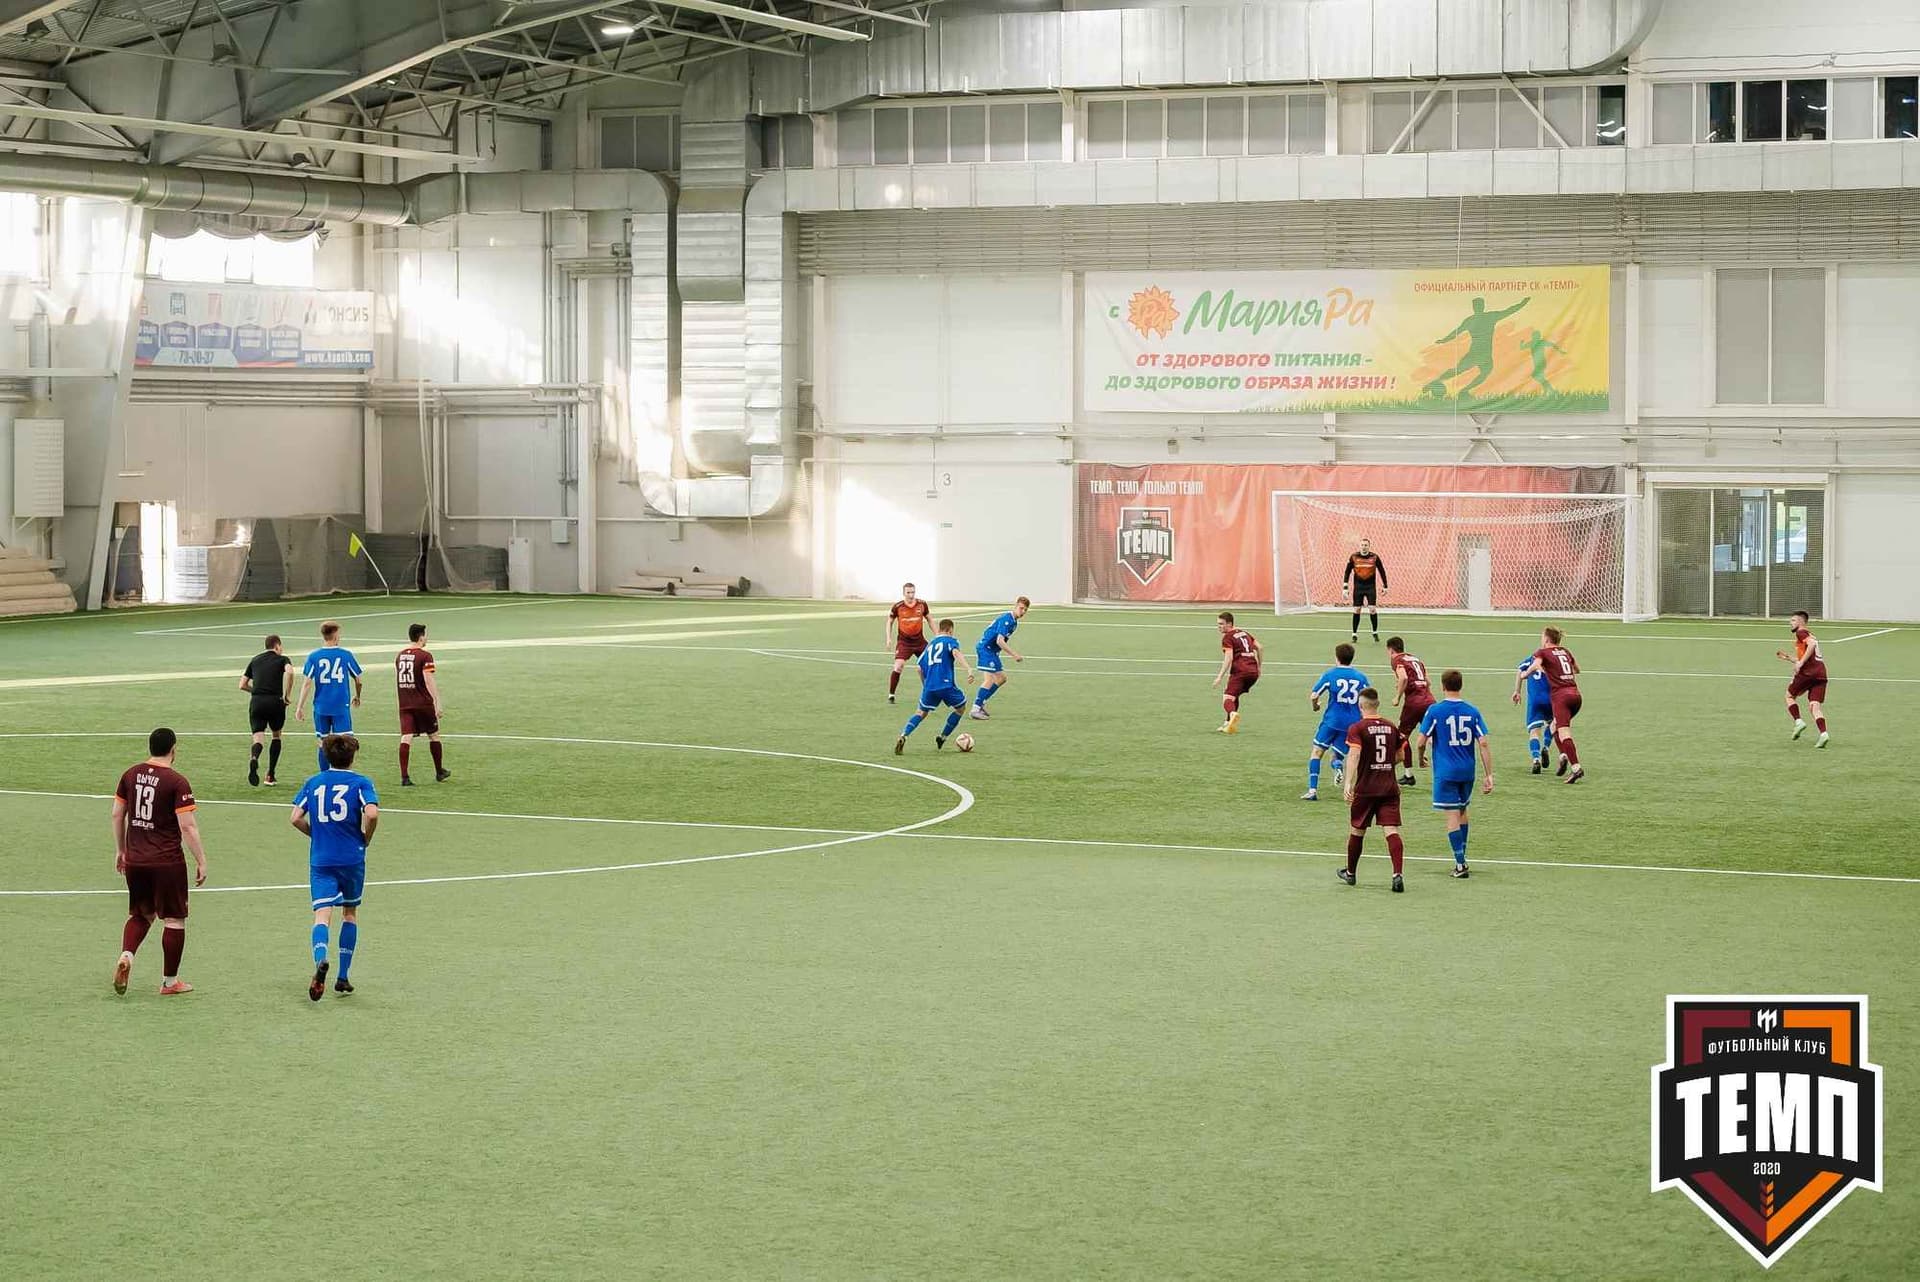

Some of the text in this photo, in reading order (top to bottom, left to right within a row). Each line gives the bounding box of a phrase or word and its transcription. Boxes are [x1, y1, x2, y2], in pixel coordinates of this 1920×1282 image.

[1414, 279, 1580, 294] ОФИЦИАЛЬНЫЙ ПАРТНЕР СК «ТЕМП»
[1136, 353, 1160, 367] ОТ
[1162, 353, 1271, 369] ЗДОРОВОГО
[1104, 376, 1132, 391] ДО
[1134, 376, 1241, 391] ЗДОРОВОГО
[1244, 376, 1313, 389] ОБРАЗА
[943, 472, 952, 486] 3
[1122, 528, 1169, 557] ТЕМП
[927, 641, 944, 666] 12
[1557, 655, 1572, 675] 6
[318, 657, 345, 684] 24
[399, 661, 415, 683] 23
[1336, 678, 1360, 705] 23
[1445, 715, 1473, 747] 15
[1375, 734, 1387, 763] 5
[135, 784, 155, 820] 13
[313, 784, 350, 823] 13
